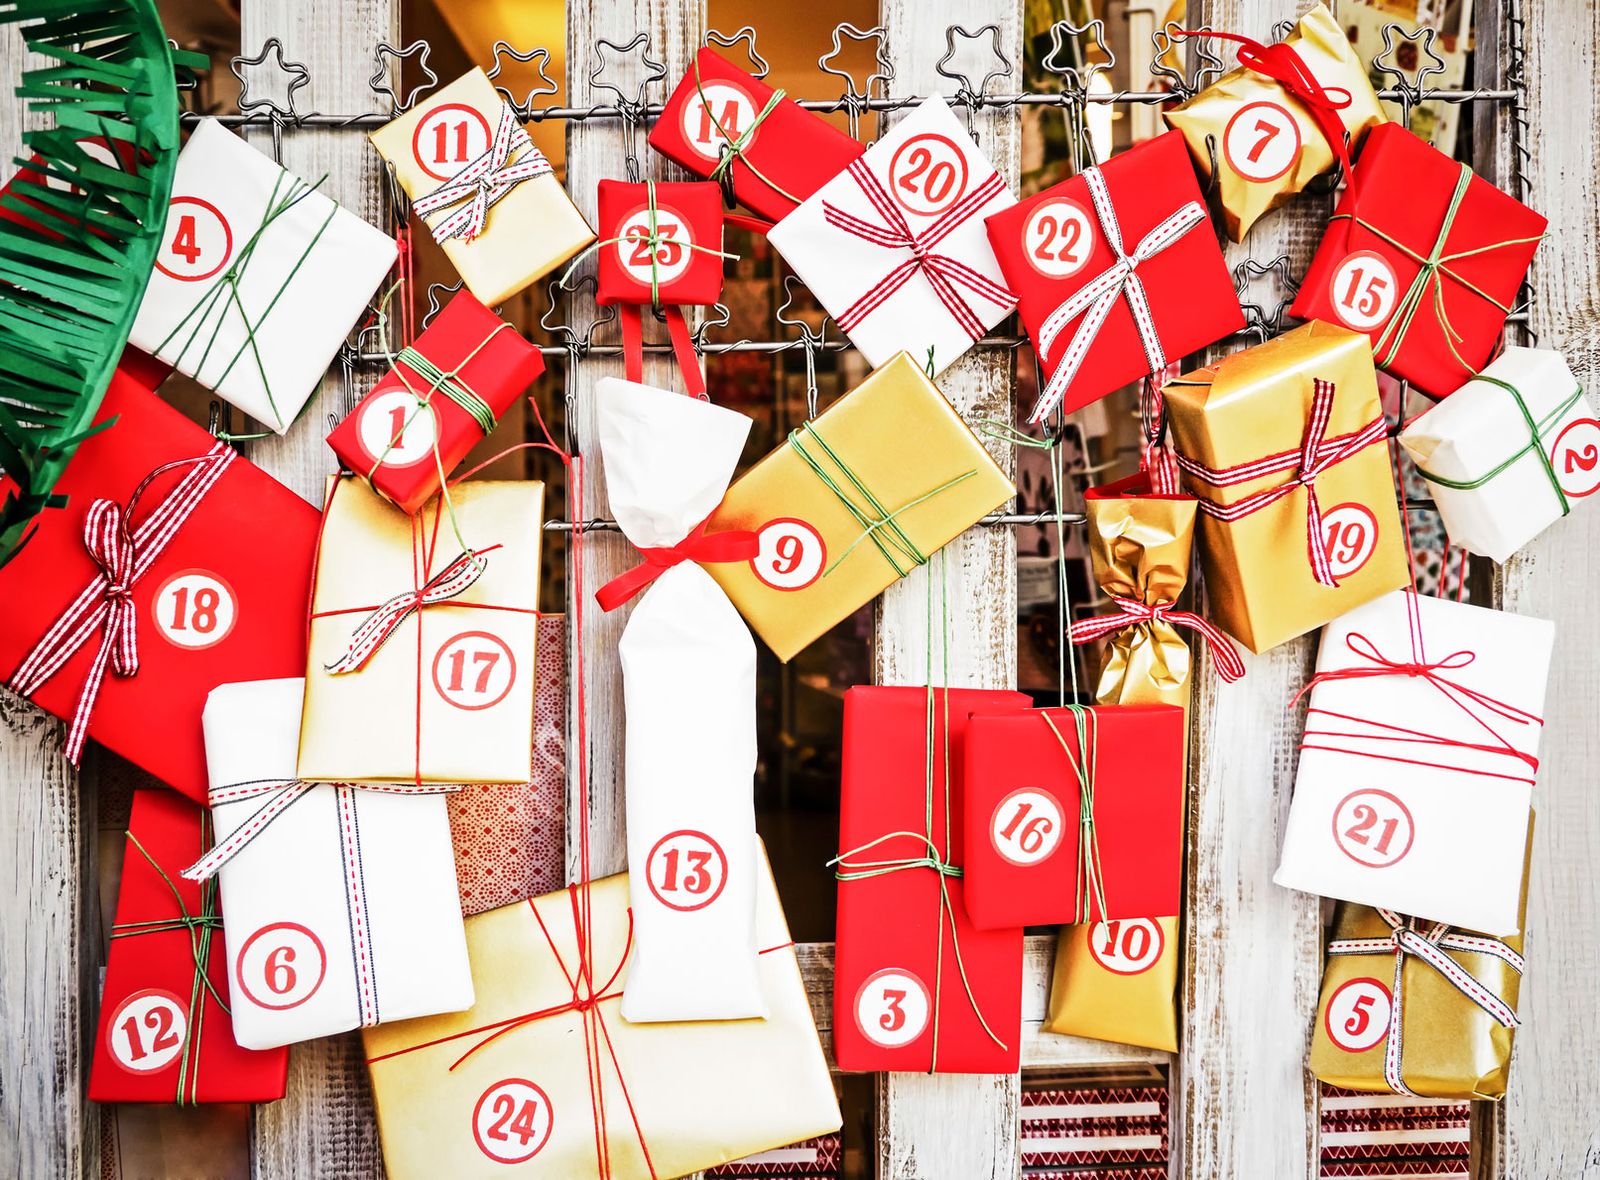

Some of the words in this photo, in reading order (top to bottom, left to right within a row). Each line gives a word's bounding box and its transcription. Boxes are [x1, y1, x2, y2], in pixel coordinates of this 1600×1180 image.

[433, 121, 469, 163] 11
[697, 99, 743, 145] 14
[1248, 120, 1280, 162] 7
[899, 148, 956, 203] 20
[172, 216, 201, 264] 4
[626, 224, 682, 267] 23
[1035, 216, 1082, 263] 22
[1342, 267, 1387, 318] 15
[388, 406, 408, 449] 1
[1565, 445, 1598, 473] 2
[772, 535, 804, 574] 9
[1325, 522, 1366, 565] 19
[171, 587, 220, 634] 18
[447, 650, 500, 693] 17
[999, 803, 1053, 854] 16
[1344, 804, 1398, 855] 21
[660, 848, 712, 894] 13
[1102, 920, 1152, 962] 10
[264, 945, 297, 995] 6
[120, 1005, 180, 1061] 12
[879, 989, 907, 1031] 3
[1344, 995, 1376, 1036] 5
[486, 1094, 538, 1146] 24
